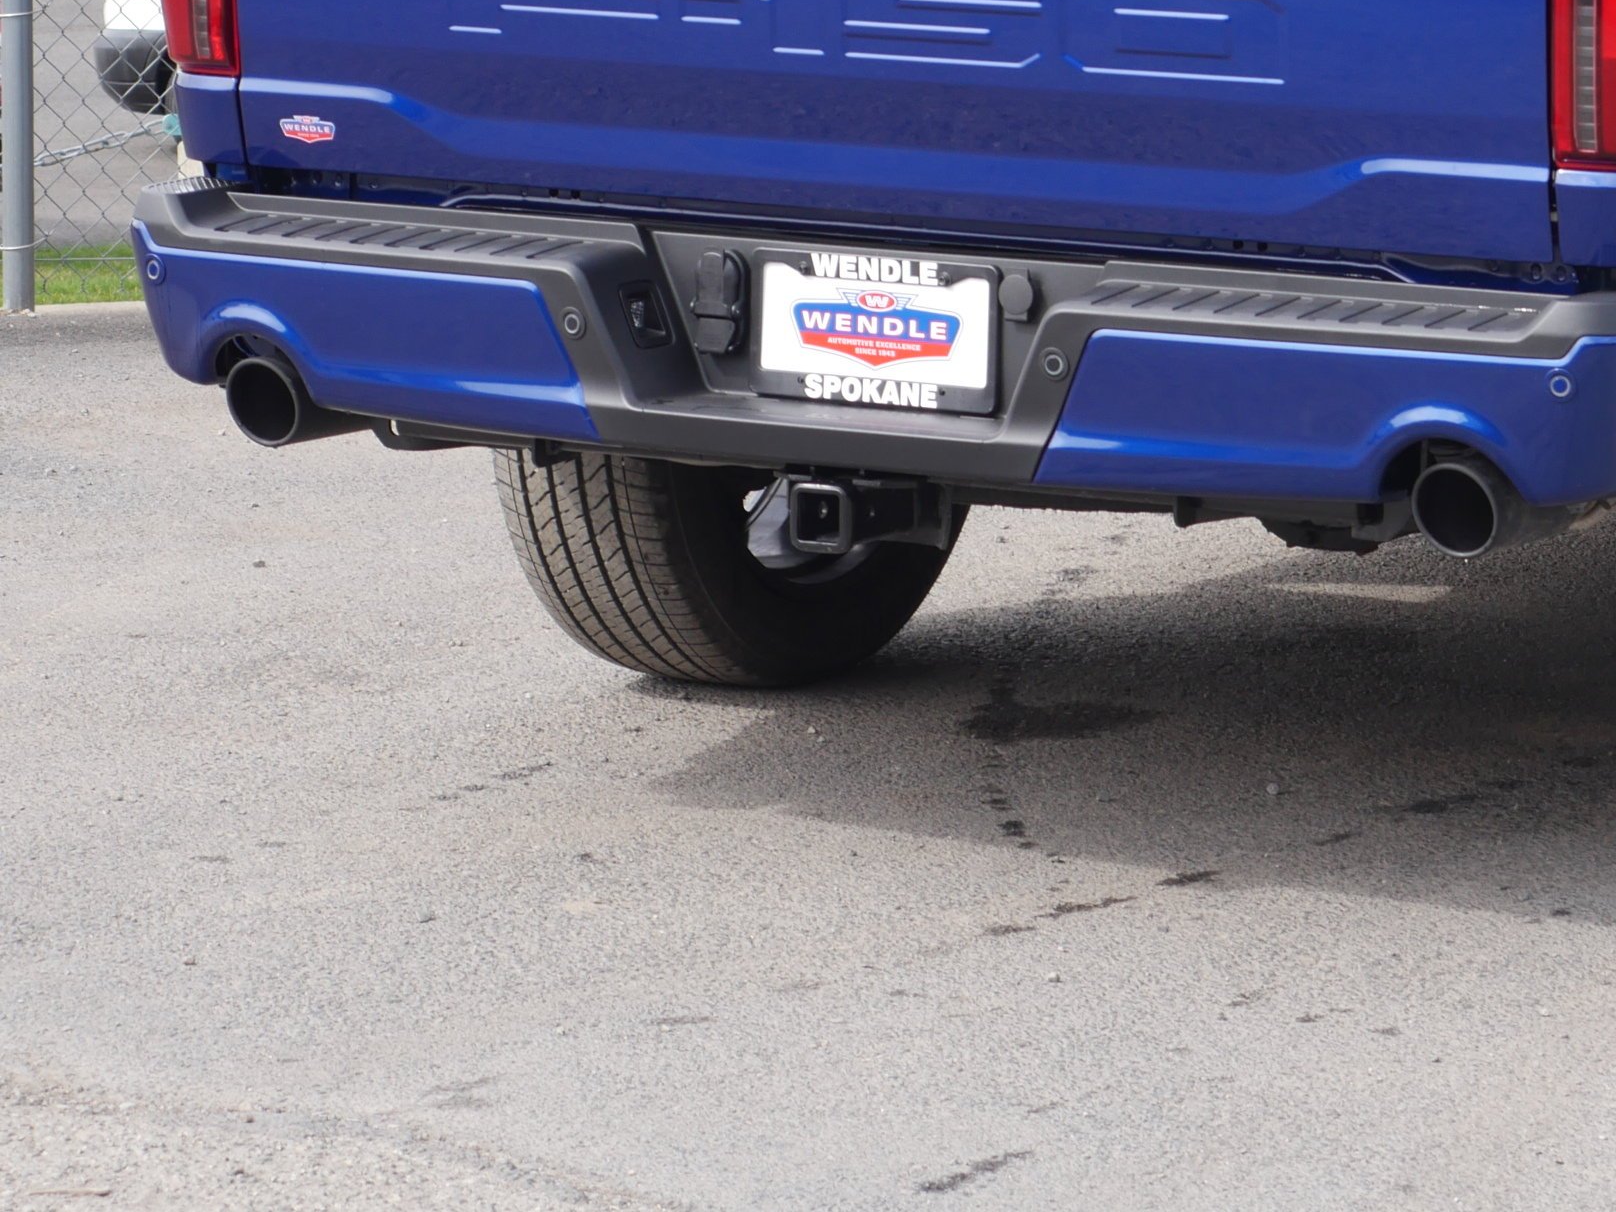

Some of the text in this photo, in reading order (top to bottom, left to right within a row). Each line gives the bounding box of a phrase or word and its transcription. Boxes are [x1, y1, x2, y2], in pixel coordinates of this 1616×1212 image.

[284, 123, 331, 133] WENDLE
[810, 252, 939, 285] WENDLE
[864, 294, 889, 308] W
[802, 310, 947, 340] WENDLE
[827, 336, 922, 352] AUTOMOTIVE EXCELLENCE
[855, 347, 877, 356] SINCE
[804, 373, 938, 409] SPOKANE
